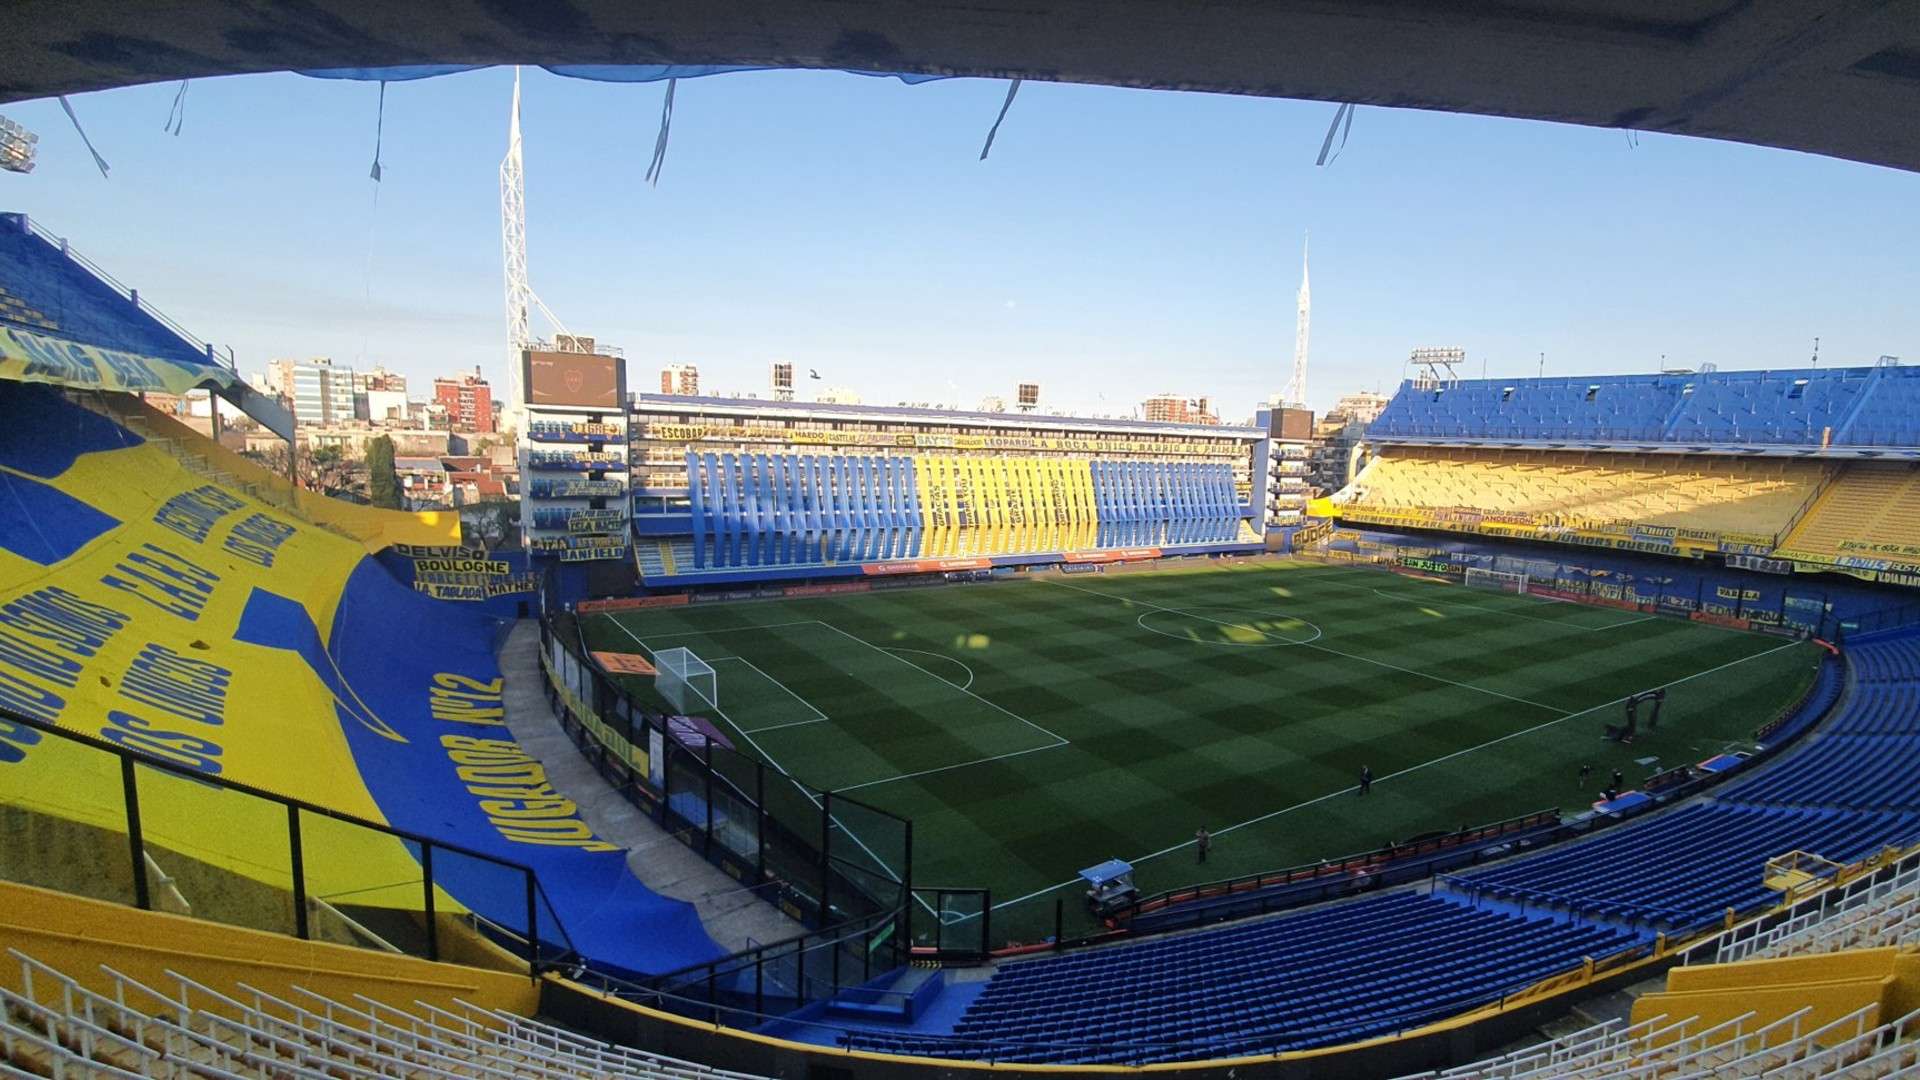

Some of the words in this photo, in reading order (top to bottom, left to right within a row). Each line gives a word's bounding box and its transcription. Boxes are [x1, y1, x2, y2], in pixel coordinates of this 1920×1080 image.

[1057, 440, 1089, 450] BOCA
[1097, 441, 1133, 451] UNICO
[1140, 443, 1179, 452] BARRIO
[933, 485, 945, 527] GRACIAS
[1355, 514, 1398, 524] SIEMPRE
[1461, 524, 1475, 532] TU
[1479, 525, 1511, 535] LADO
[1515, 529, 1550, 540] BOCA
[1556, 533, 1612, 546] JUNIORS
[1617, 539, 1680, 554] QUERIDO
[560, 548, 623, 559] BANFIELD
[417, 560, 506, 573] BOULOGNE
[436, 585, 482, 598] TABLADA
[1719, 587, 1759, 599] VARLA
[117, 642, 233, 726] UNICOS
[439, 734, 622, 852] JUGADOR
